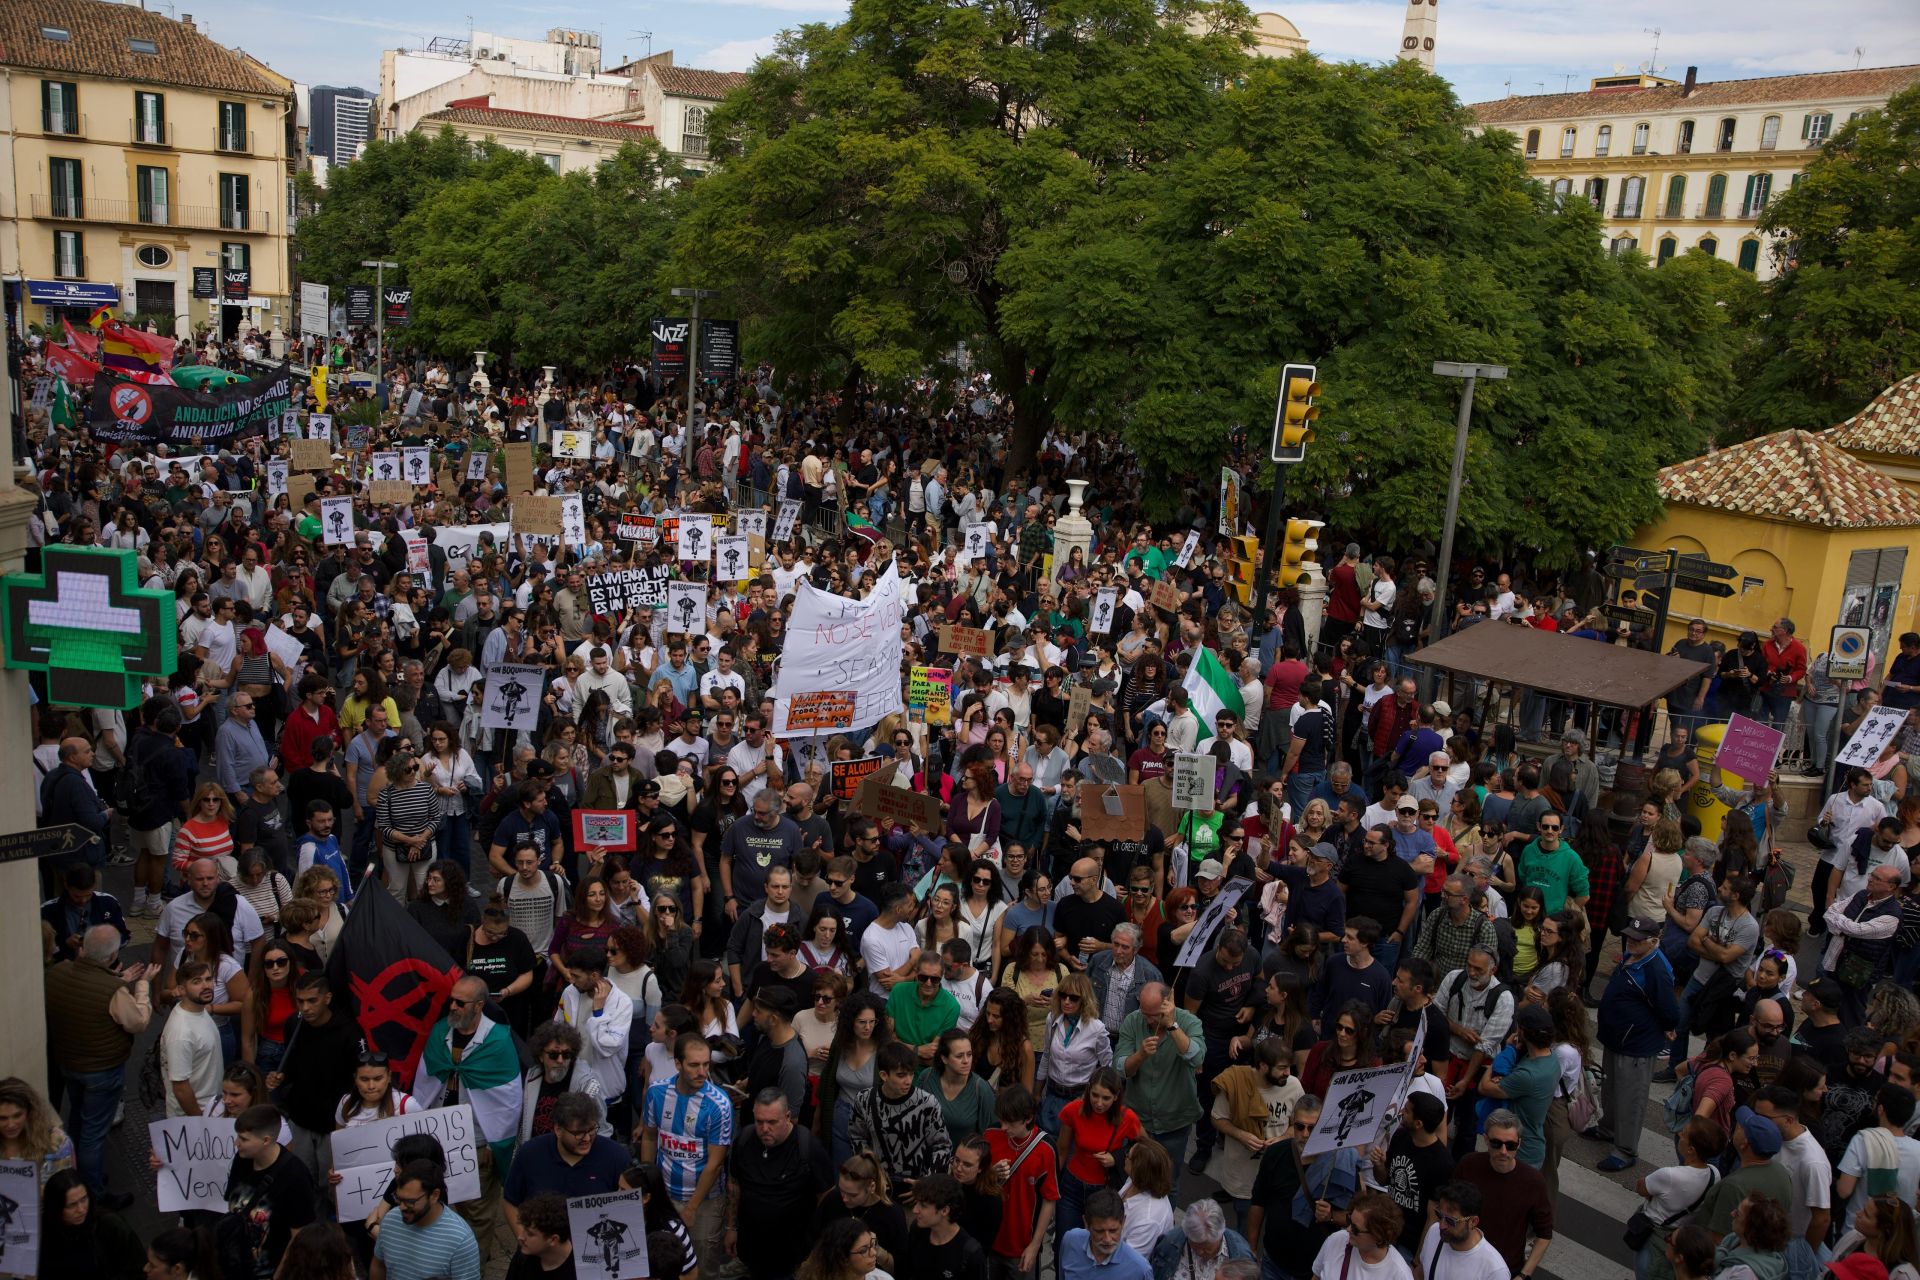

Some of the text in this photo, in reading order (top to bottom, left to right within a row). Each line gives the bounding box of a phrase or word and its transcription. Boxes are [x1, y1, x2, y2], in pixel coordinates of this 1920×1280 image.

[224, 272, 249, 283] JAZZ
[384, 291, 412, 304] JAZZ
[652, 323, 689, 343] JAZZ
[237, 399, 251, 417] NO
[586, 563, 670, 587] LA VIVIENDA NO
[590, 579, 668, 602] ES TU JUGUETE
[594, 591, 668, 615] ES UN DERECHO
[815, 622, 848, 645] NO
[851, 612, 875, 640] SE
[502, 665, 543, 676] BOQUERONES
[835, 658, 864, 685] SE
[912, 680, 931, 688] PARA
[792, 707, 818, 715] TODOS
[831, 714, 850, 723] POCOS
[833, 758, 881, 777] SE ALQUILA
[588, 819, 620, 827] MONOPOLY
[28, 830, 62, 843] PICASSO
[9, 847, 34, 858] NATAL
[1333, 1064, 1408, 1086] SIN BOQUERONES
[660, 1132, 697, 1153] Tivoli
[673, 1151, 687, 1159] DEL
[569, 1190, 640, 1209] SIN BOQUERONES
